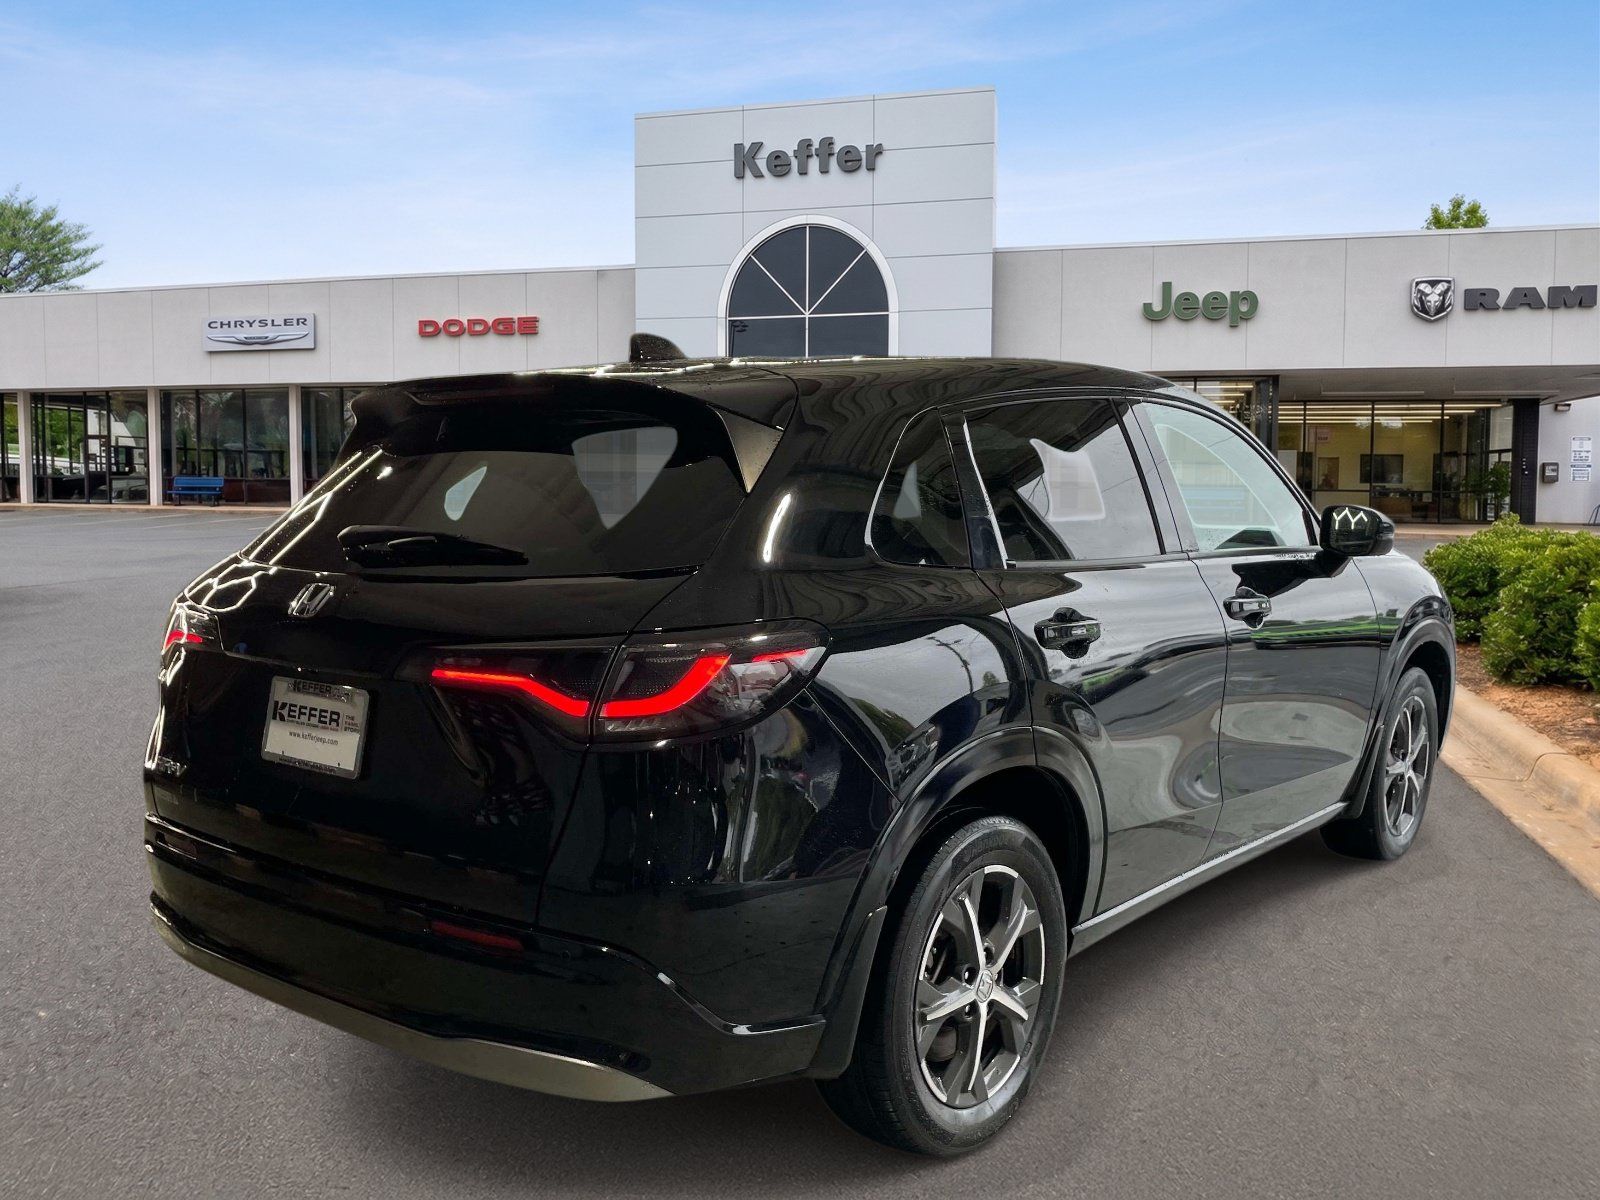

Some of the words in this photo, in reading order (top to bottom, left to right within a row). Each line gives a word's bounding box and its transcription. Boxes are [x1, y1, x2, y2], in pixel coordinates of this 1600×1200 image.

[733, 136, 883, 179] Keffer
[1142, 281, 1259, 328] Jeep
[1463, 284, 1598, 311] RAM
[207, 317, 303, 329] CHRYSLER
[418, 316, 539, 337] DODGE
[272, 700, 341, 728] KEFFER
